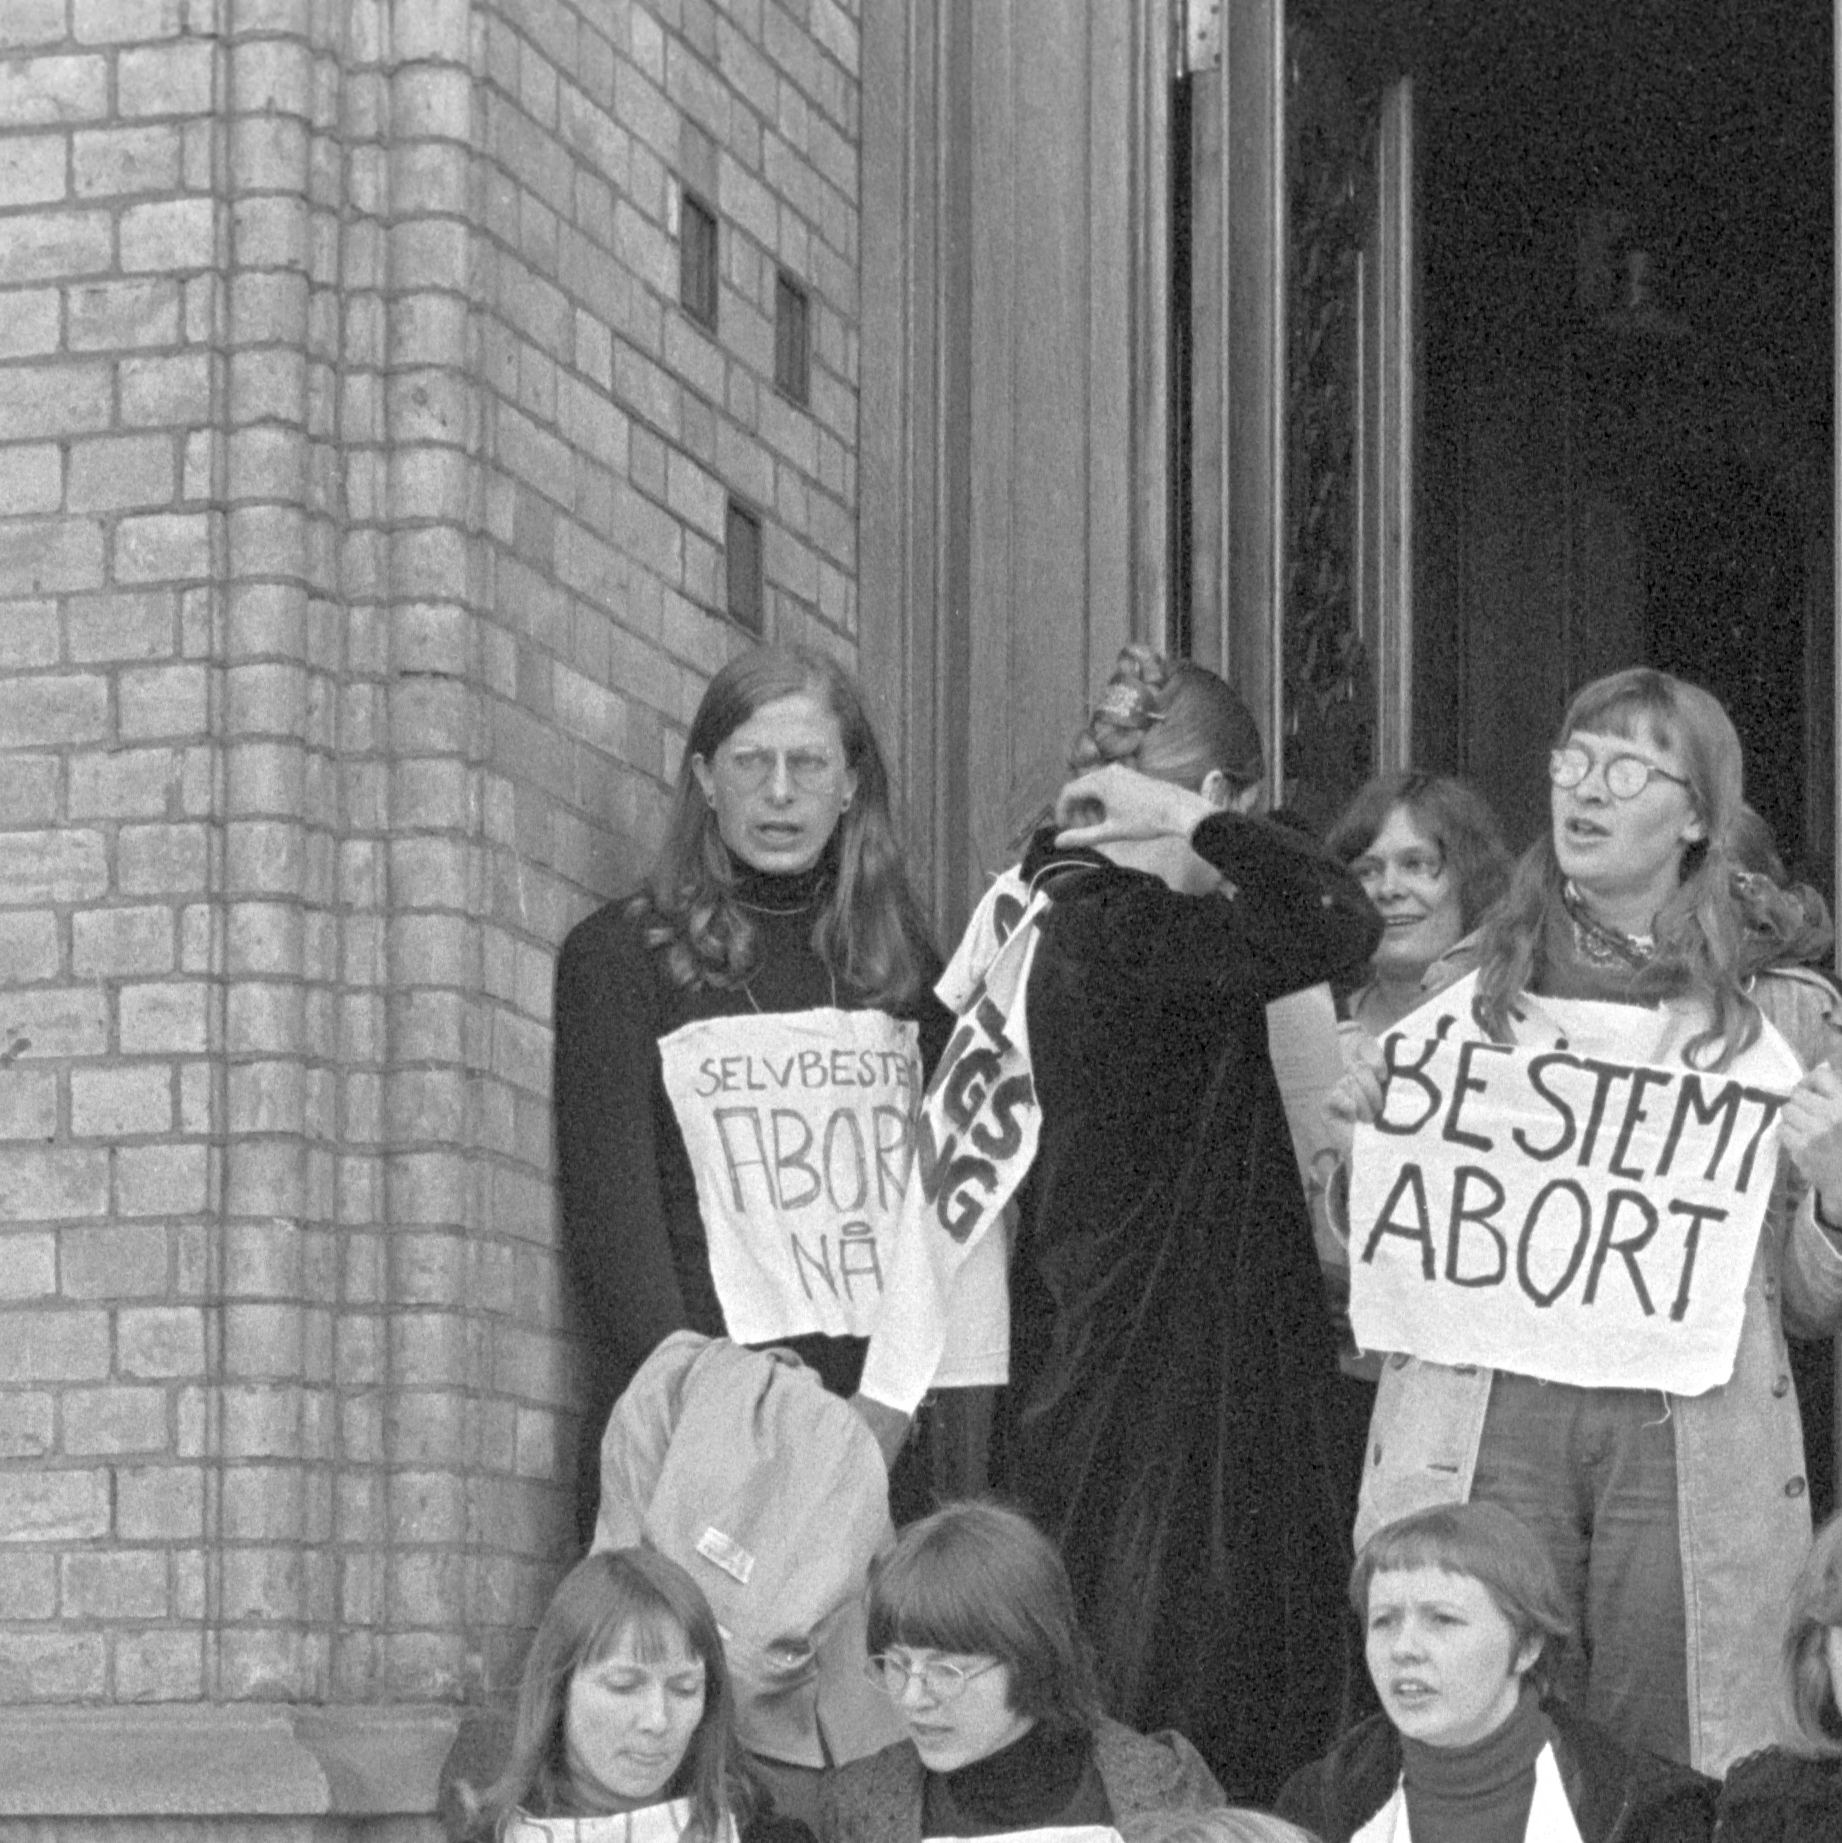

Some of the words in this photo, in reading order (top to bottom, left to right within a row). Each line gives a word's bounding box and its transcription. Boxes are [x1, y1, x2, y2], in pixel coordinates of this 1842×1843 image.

[1372, 1013, 1794, 1194] BESTEMT
[791, 1220, 885, 1302] NÅ
[1361, 1162, 1729, 1322] ABORT
